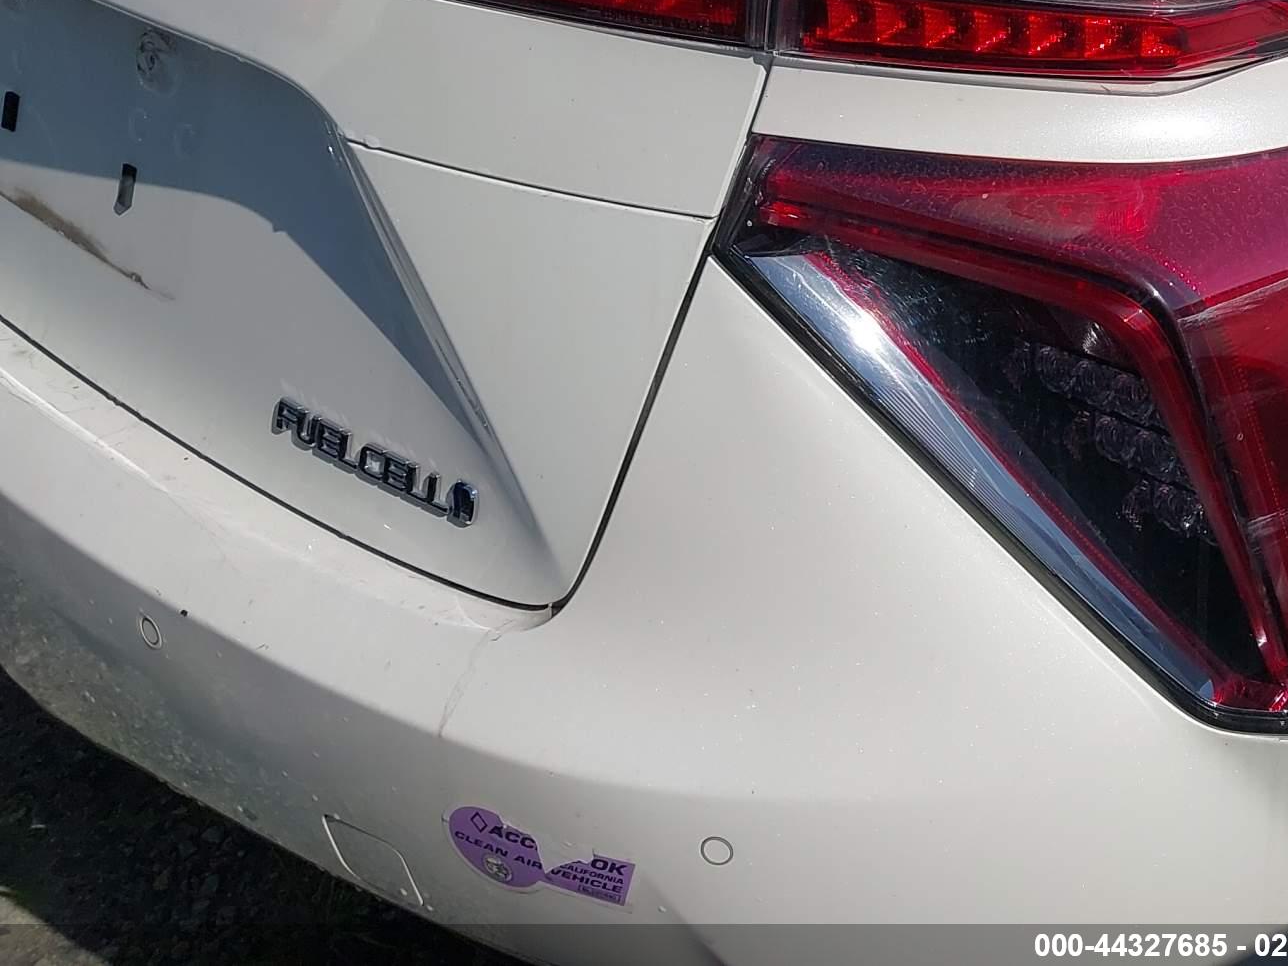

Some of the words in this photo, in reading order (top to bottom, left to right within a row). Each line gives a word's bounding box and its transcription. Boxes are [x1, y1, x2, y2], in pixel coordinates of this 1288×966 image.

[454, 830, 508, 858] CLEAN
[513, 854, 543, 870] AIR
[550, 868, 624, 894] VEHICLE
[590, 858, 627, 876] OK
